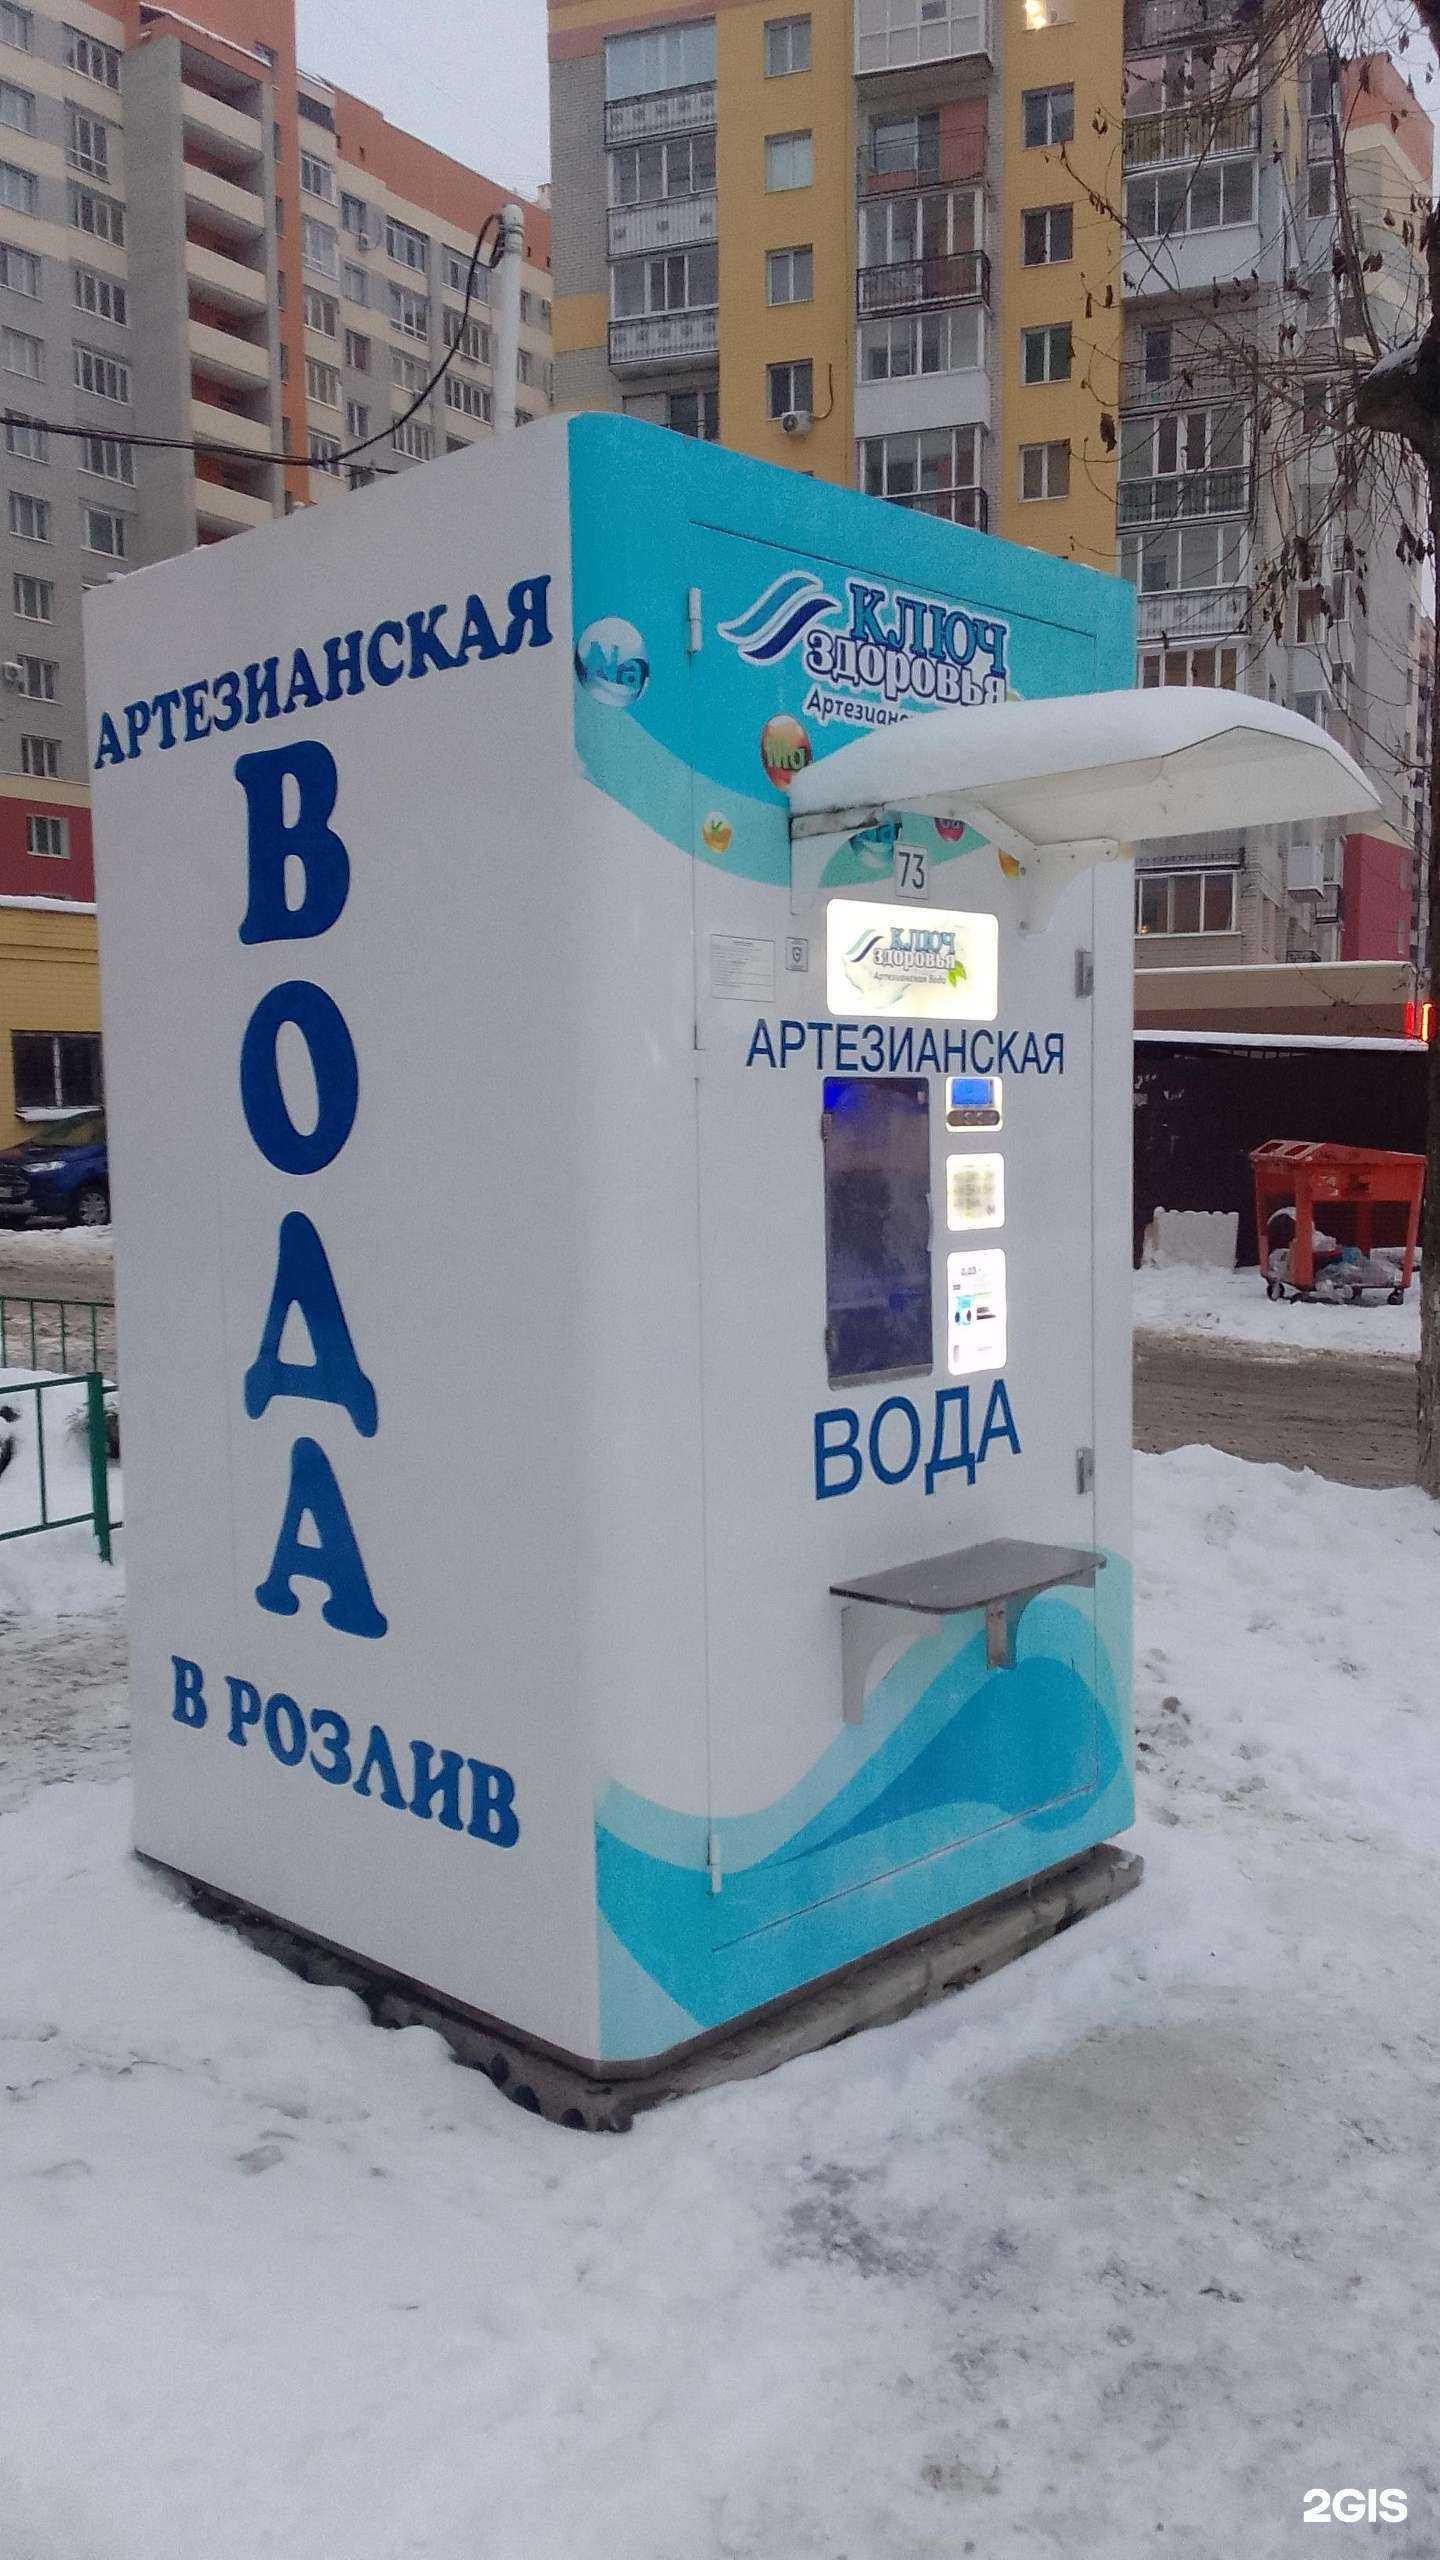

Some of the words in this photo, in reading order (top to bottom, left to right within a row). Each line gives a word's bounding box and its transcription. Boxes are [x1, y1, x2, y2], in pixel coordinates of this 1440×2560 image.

[93, 574, 554, 770] АРТЕЗИАНСКАЯ
[806, 629, 1008, 706] здоровья
[849, 582, 1008, 677] КЛЮЧ
[898, 851, 925, 890] 73
[889, 927, 956, 956] КЛЮЧ
[745, 1018, 1065, 1075] АРТЕЗИАНСКАЯ
[234, 740, 388, 1639] ВОДА
[814, 1378, 1022, 1501] ВОДА
[171, 1654, 208, 1729] В
[224, 1675, 520, 1848] РОЗЛИВ
